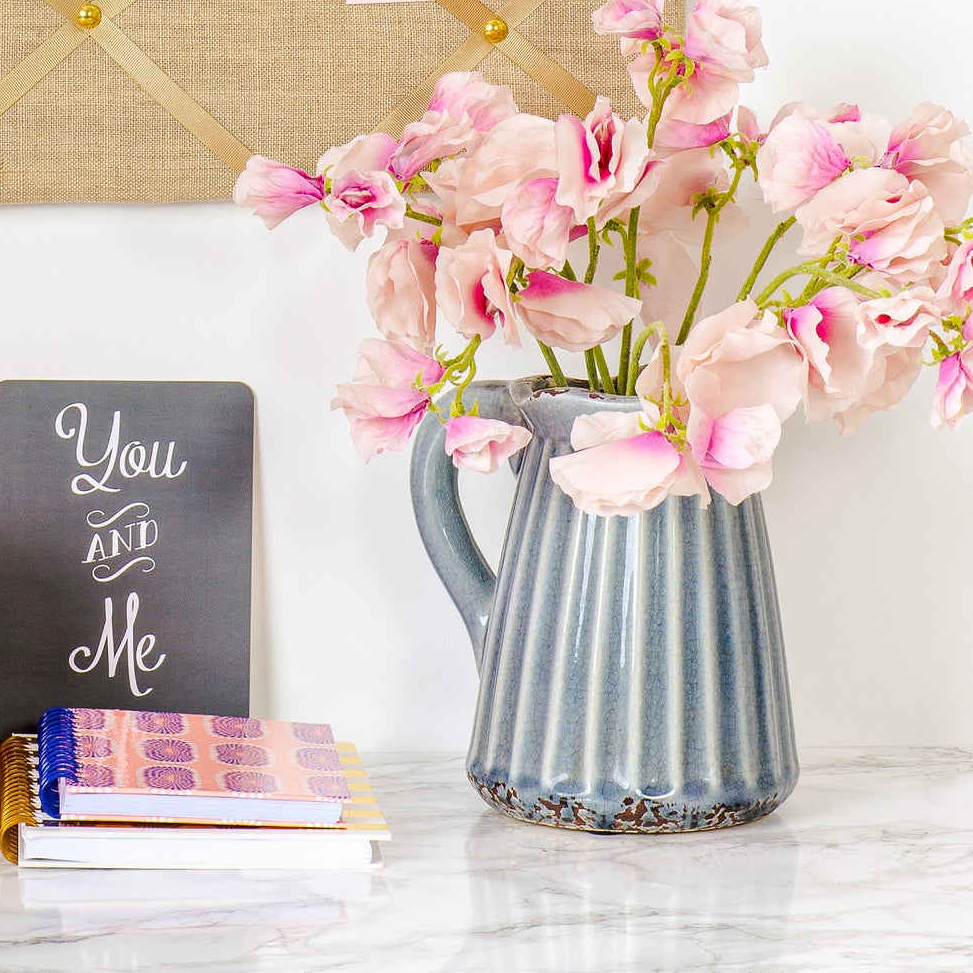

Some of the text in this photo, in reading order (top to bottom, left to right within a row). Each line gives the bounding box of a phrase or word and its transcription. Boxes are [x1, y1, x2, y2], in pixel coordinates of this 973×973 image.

[55, 402, 187, 495] You
[81, 519, 159, 564] AND
[68, 591, 166, 697] Me
